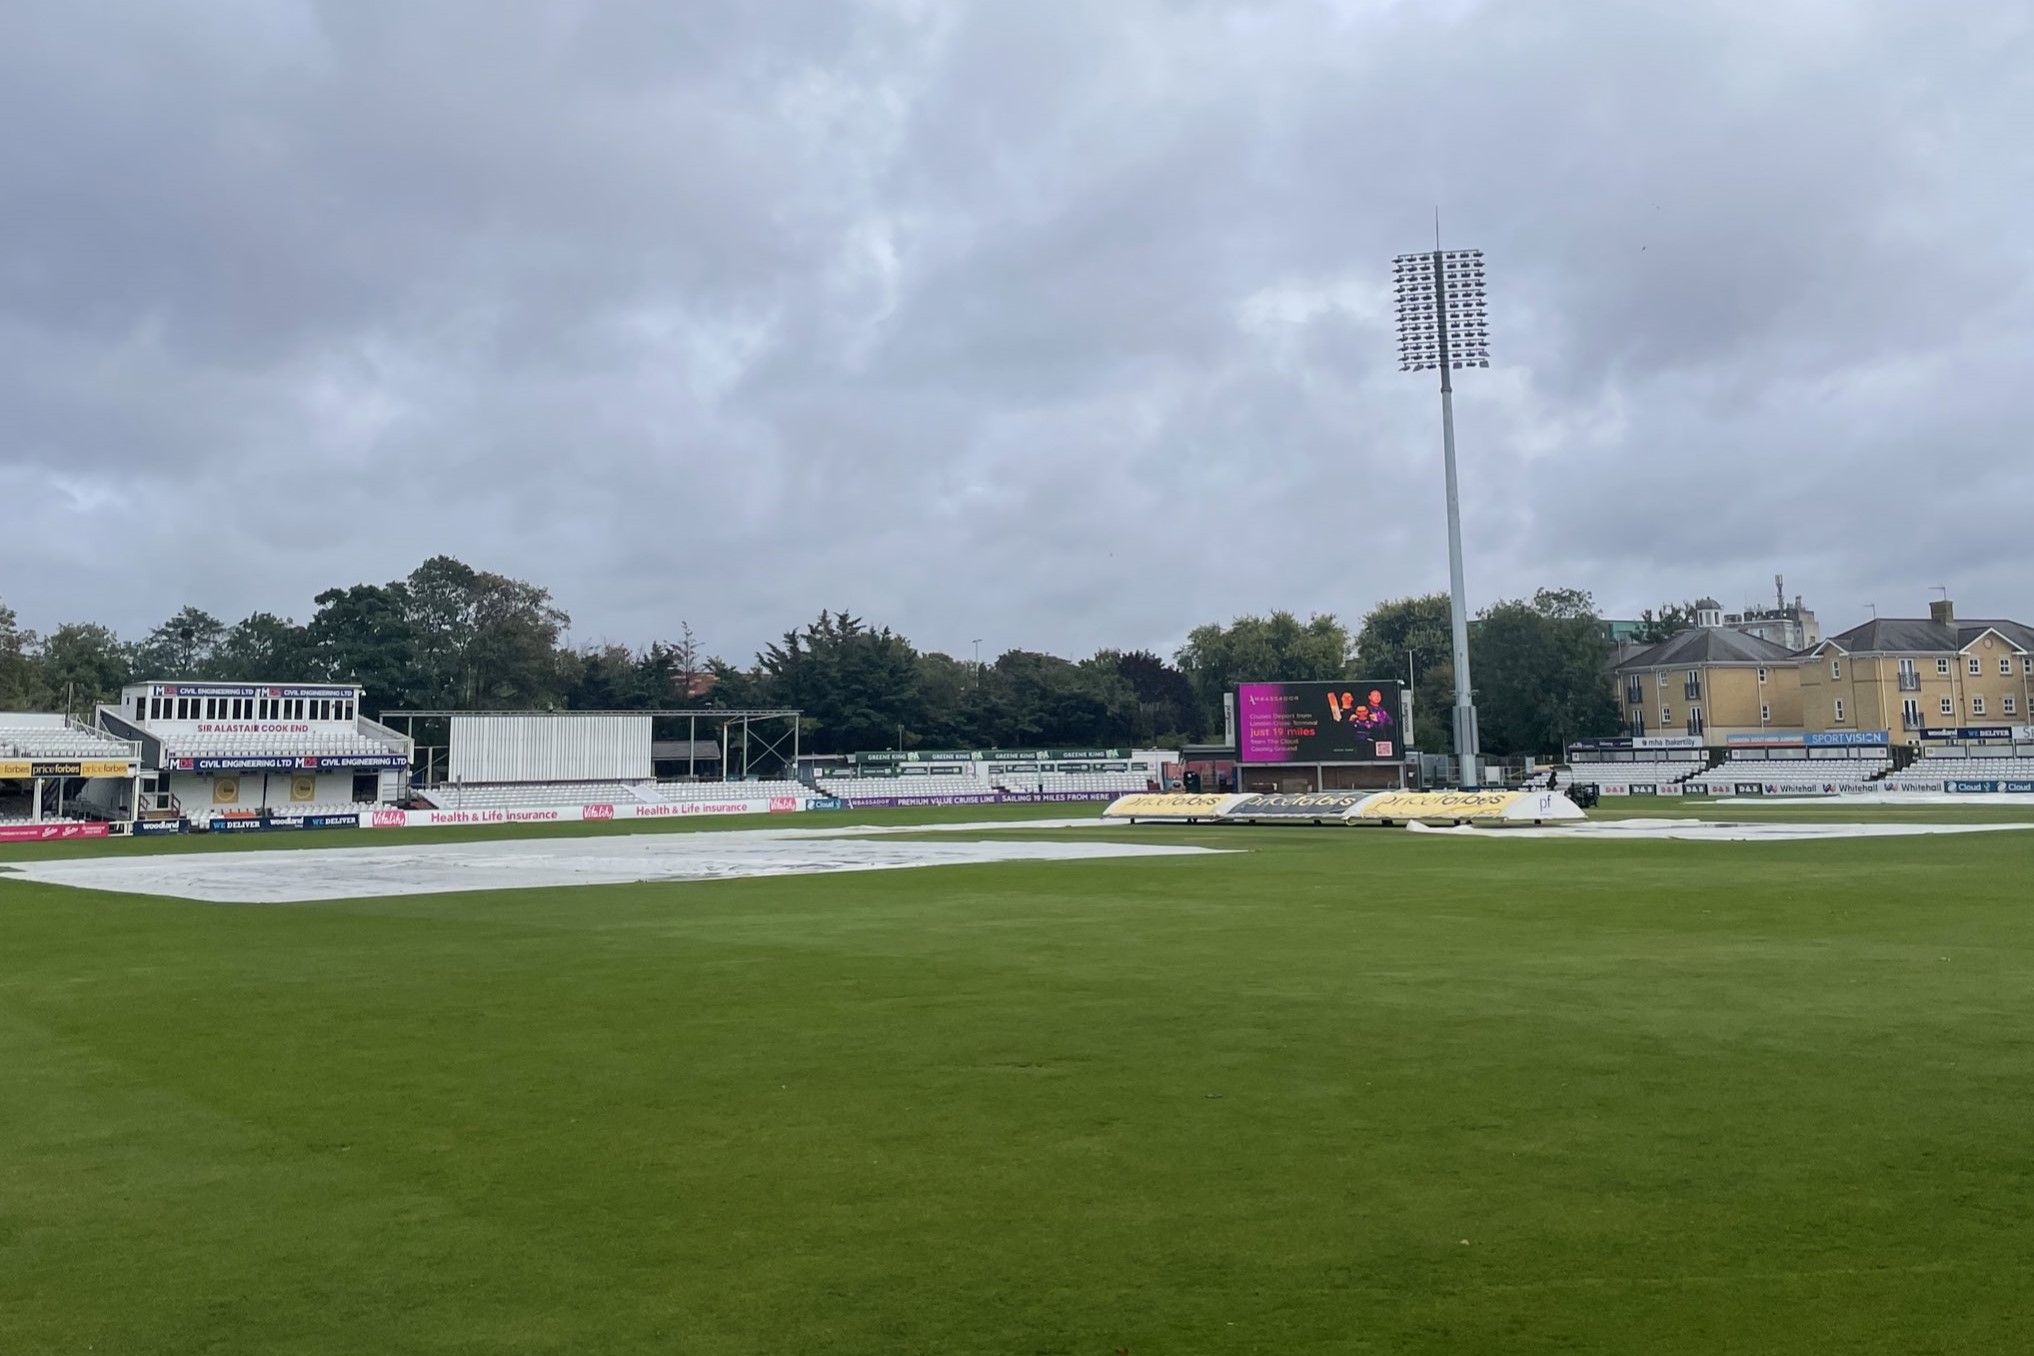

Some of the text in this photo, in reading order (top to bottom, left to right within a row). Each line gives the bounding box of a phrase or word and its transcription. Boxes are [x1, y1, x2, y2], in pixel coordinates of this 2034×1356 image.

[197, 724, 212, 732] SIR
[214, 724, 259, 732] ALASTAIR
[261, 724, 288, 732] COOK
[1273, 727, 1284, 736] 19
[1287, 727, 1316, 736] miles
[1980, 729, 2010, 737] DELIVER
[170, 759, 292, 770] MDS CIVIL ENGINEERING LTD
[295, 757, 407, 768] MDS CIVIL ENGINEERING LTD
[1780, 784, 1817, 792] Whitehall
[1839, 783, 1878, 792] Whitehall
[1901, 782, 1941, 792] Whitehall
[1958, 783, 1981, 791] Cloud
[2008, 783, 2031, 791] Cloud
[897, 798, 929, 806] PREMIUM
[930, 797, 953, 805] VALUE
[955, 796, 978, 804] CRUISE
[1540, 795, 1552, 812] pf
[583, 805, 613, 820] Vitality
[636, 802, 748, 816] Health & Life insurance
[269, 816, 304, 825] woodland
[372, 811, 406, 826] Vitality
[431, 809, 558, 823] Health & Life insurance
[142, 820, 179, 830] woodland
[213, 821, 260, 829] WE DELIVER
[312, 817, 356, 826] WE DELIVER
